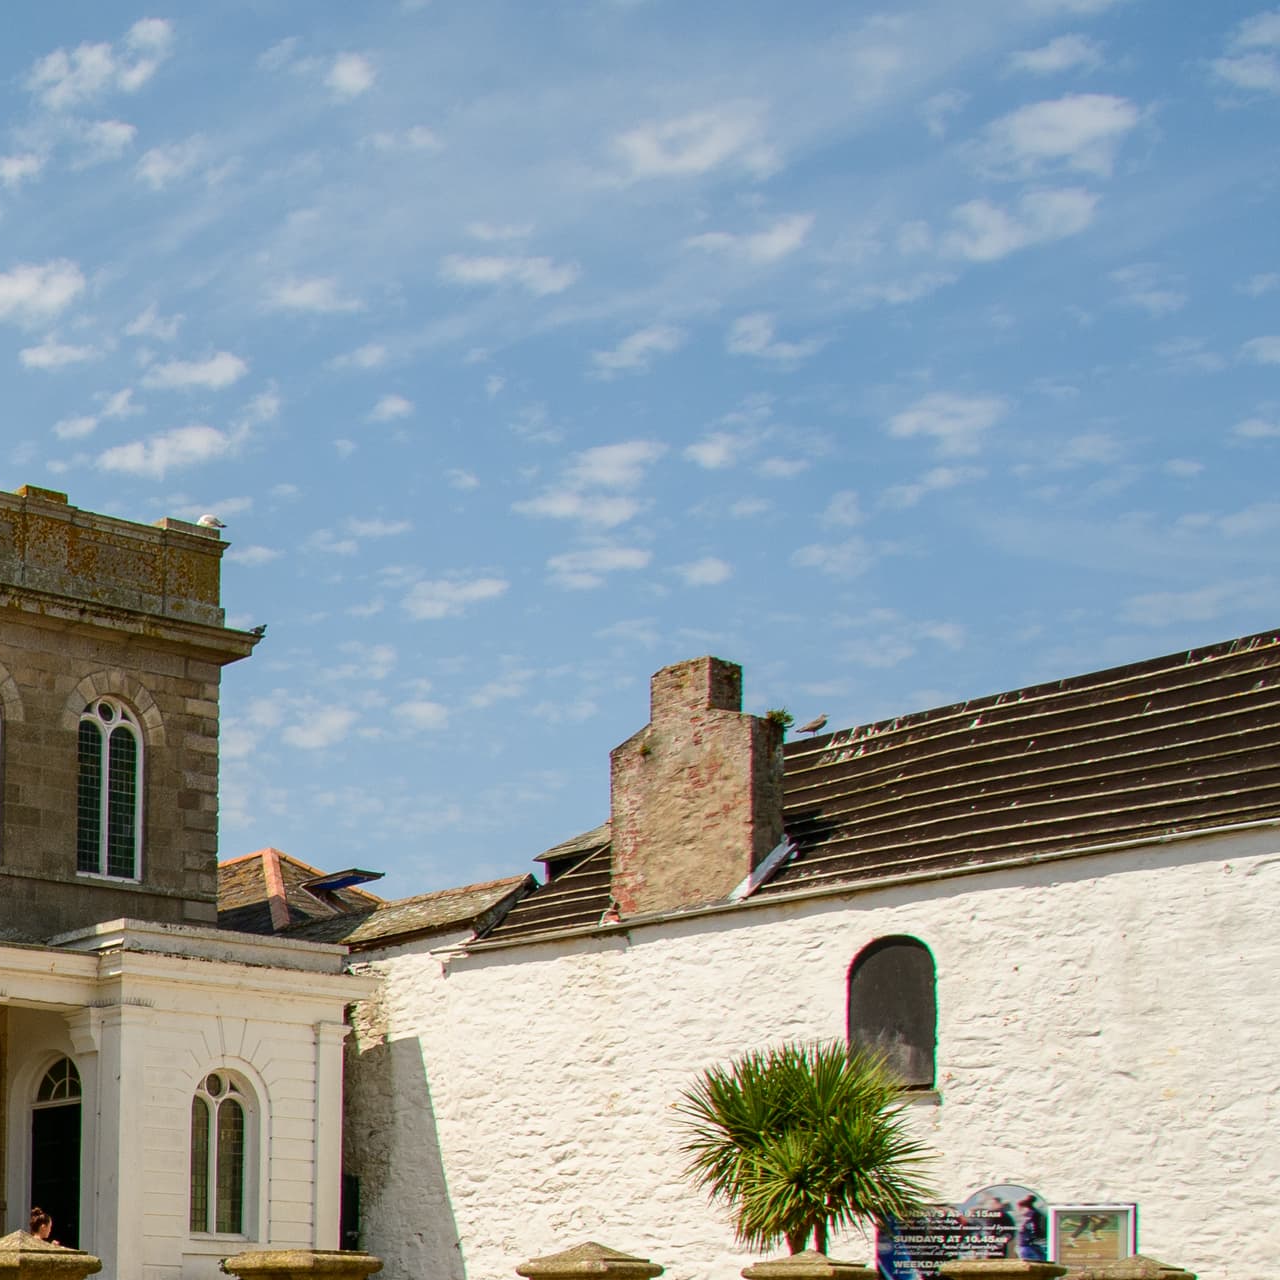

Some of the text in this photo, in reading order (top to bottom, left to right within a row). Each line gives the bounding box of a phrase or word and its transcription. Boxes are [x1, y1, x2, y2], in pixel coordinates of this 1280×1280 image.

[896, 1209, 944, 1219] UNDAYS
[894, 1235, 944, 1244] SUNDAYS
[947, 1235, 962, 1244] AT
